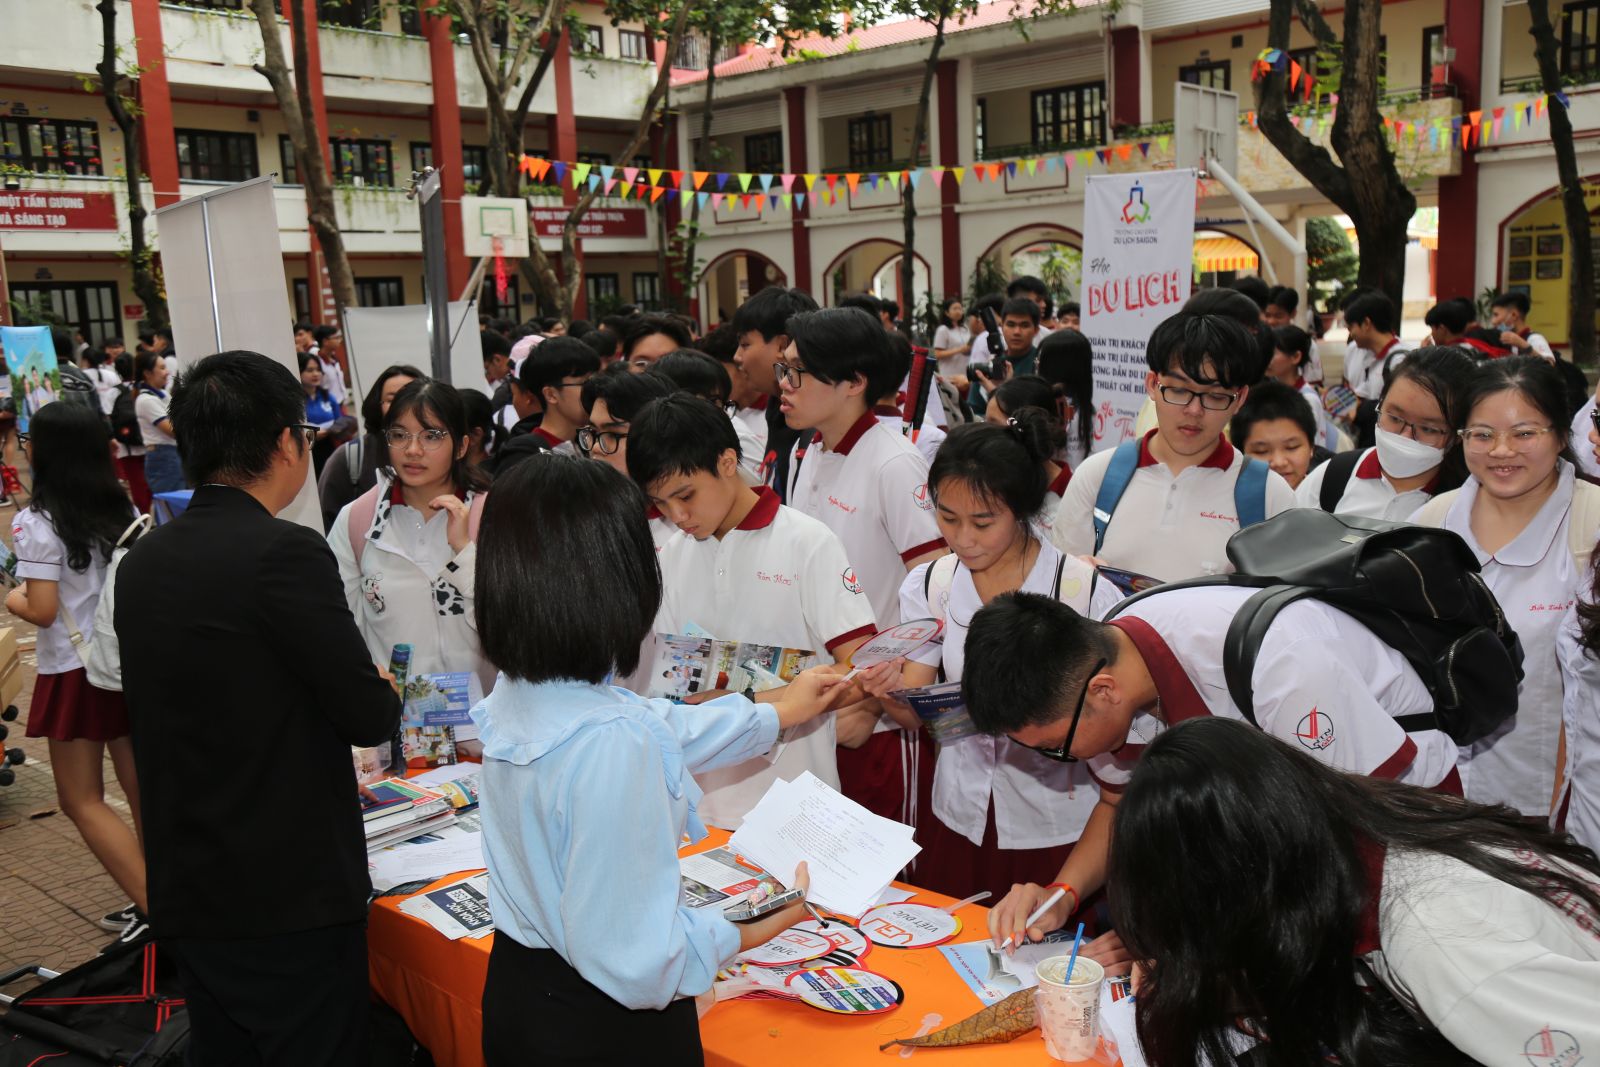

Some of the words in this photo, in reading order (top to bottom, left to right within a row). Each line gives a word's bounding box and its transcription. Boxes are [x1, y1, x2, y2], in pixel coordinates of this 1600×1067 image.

[1136, 236, 1158, 244] SAIGON
[1088, 279, 1120, 317] DU
[1124, 269, 1181, 317] LỊCH
[1130, 354, 1146, 365] HÀN
